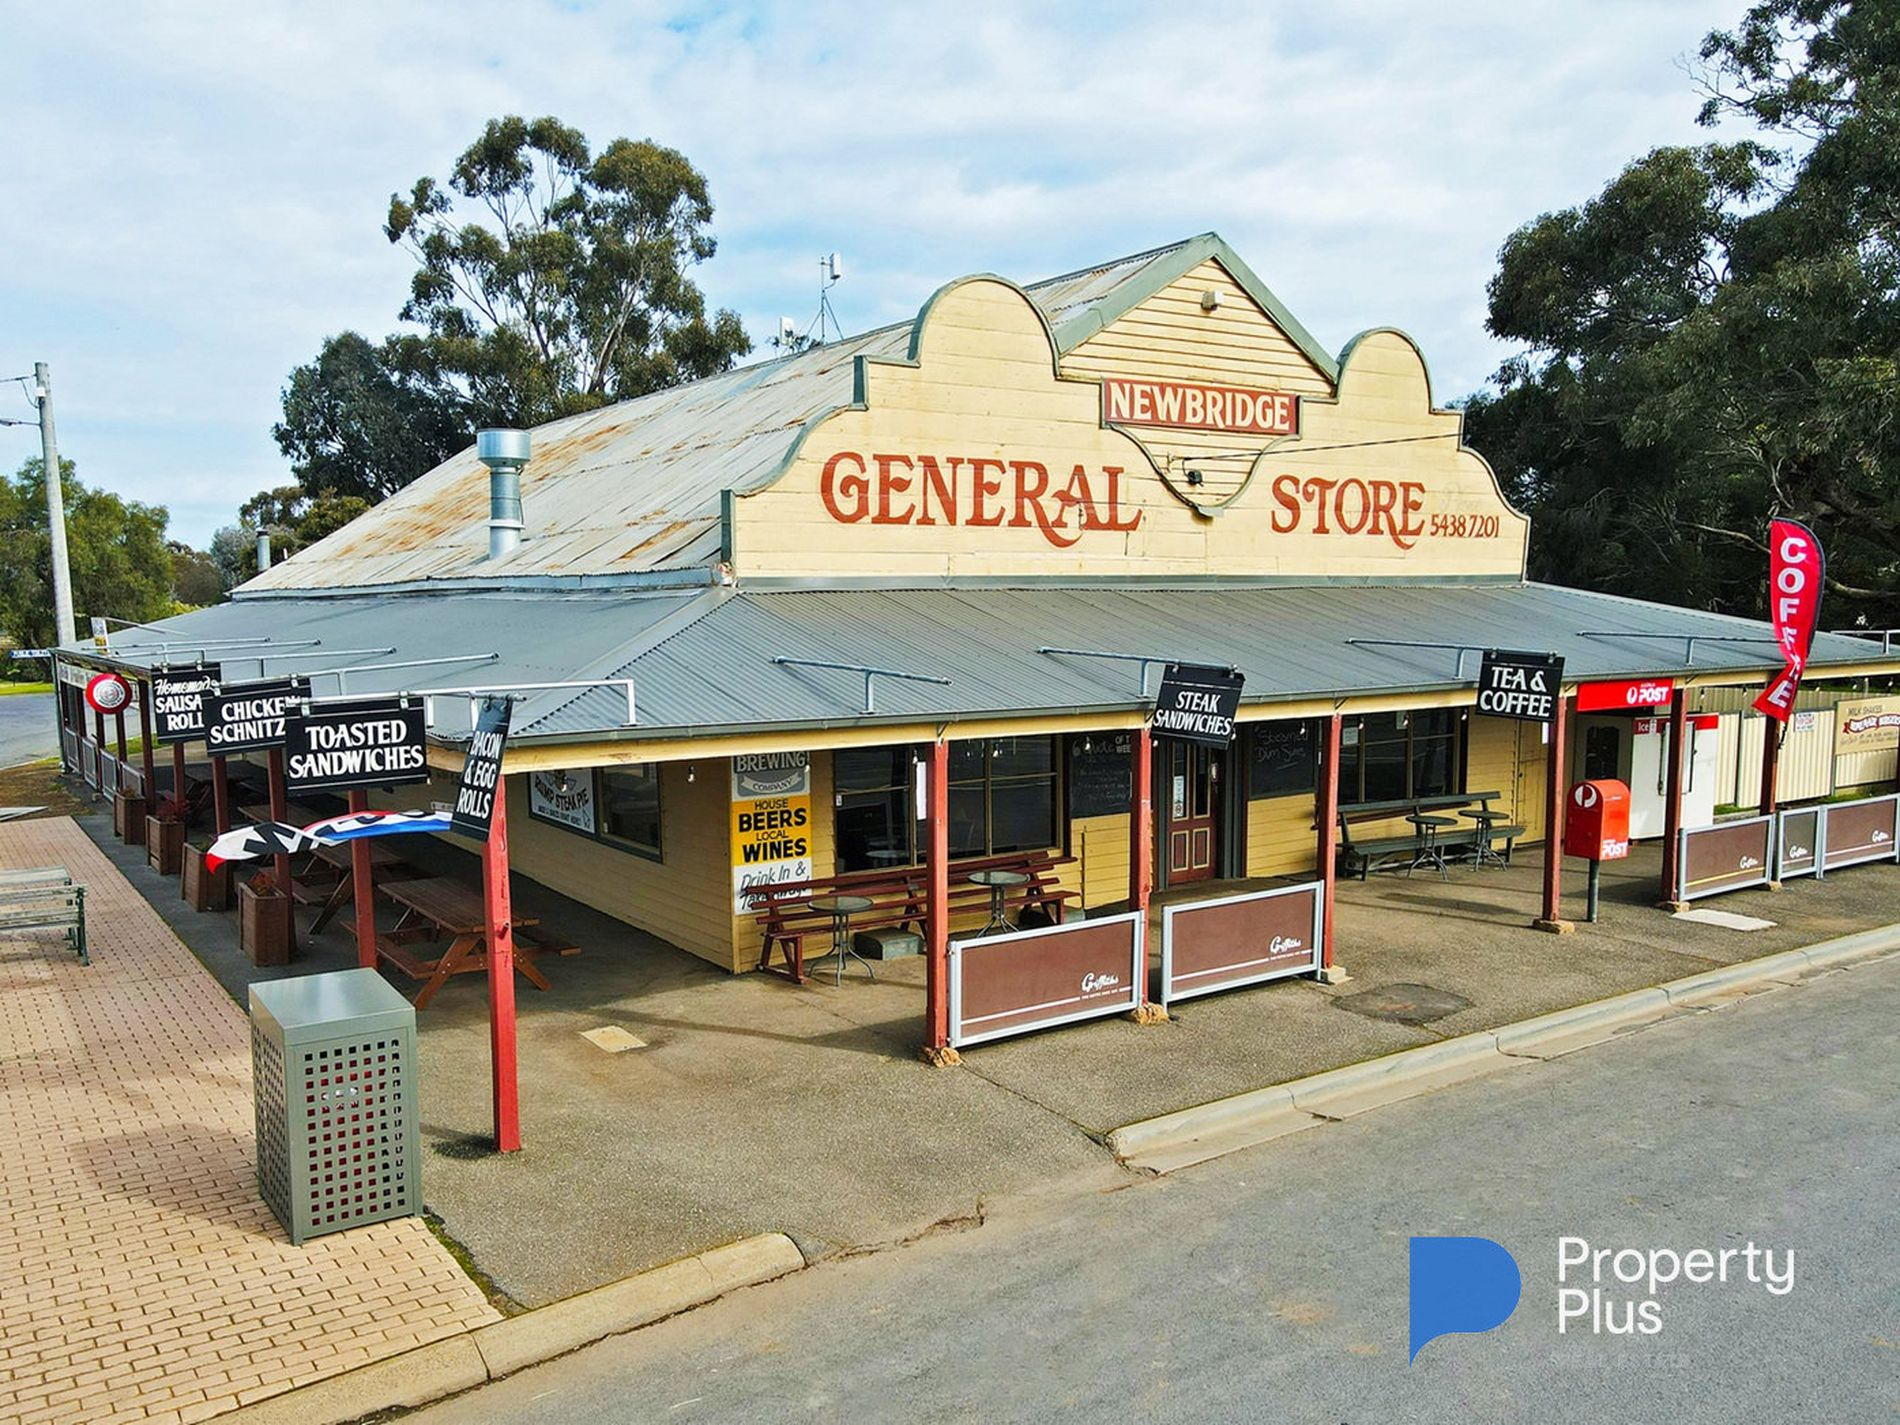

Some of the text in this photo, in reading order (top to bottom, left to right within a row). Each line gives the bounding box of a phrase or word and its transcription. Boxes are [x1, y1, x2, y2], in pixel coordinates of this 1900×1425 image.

[1110, 382, 1290, 430] NEWBRIDGE
[820, 451, 1426, 550] GENERAL STORE
[154, 675, 210, 695] Homemad
[1491, 666, 1547, 692] TEA &
[155, 694, 203, 714] SAUSA
[1175, 691, 1221, 713] STEAK
[1480, 690, 1552, 717] COFFEE
[1638, 687, 1669, 703] POST
[210, 719, 285, 744] SCHNITZ
[305, 719, 407, 750] TOASTED
[1153, 709, 1232, 735] SANDWICHES
[470, 731, 503, 759] BACON
[289, 745, 425, 778] SANDWICHES
[464, 760, 497, 788] & EGG
[736, 752, 806, 772] BREWING
[753, 779, 792, 791] COMPANY
[456, 787, 491, 819] ROLLS
[755, 799, 788, 810] HOUSE
[738, 807, 807, 832] BEERS
[756, 830, 789, 840] LOCAL
[742, 838, 807, 862] WINES
[1601, 843, 1628, 859] POST
[741, 867, 775, 892] Drink
[795, 861, 806, 877] &
